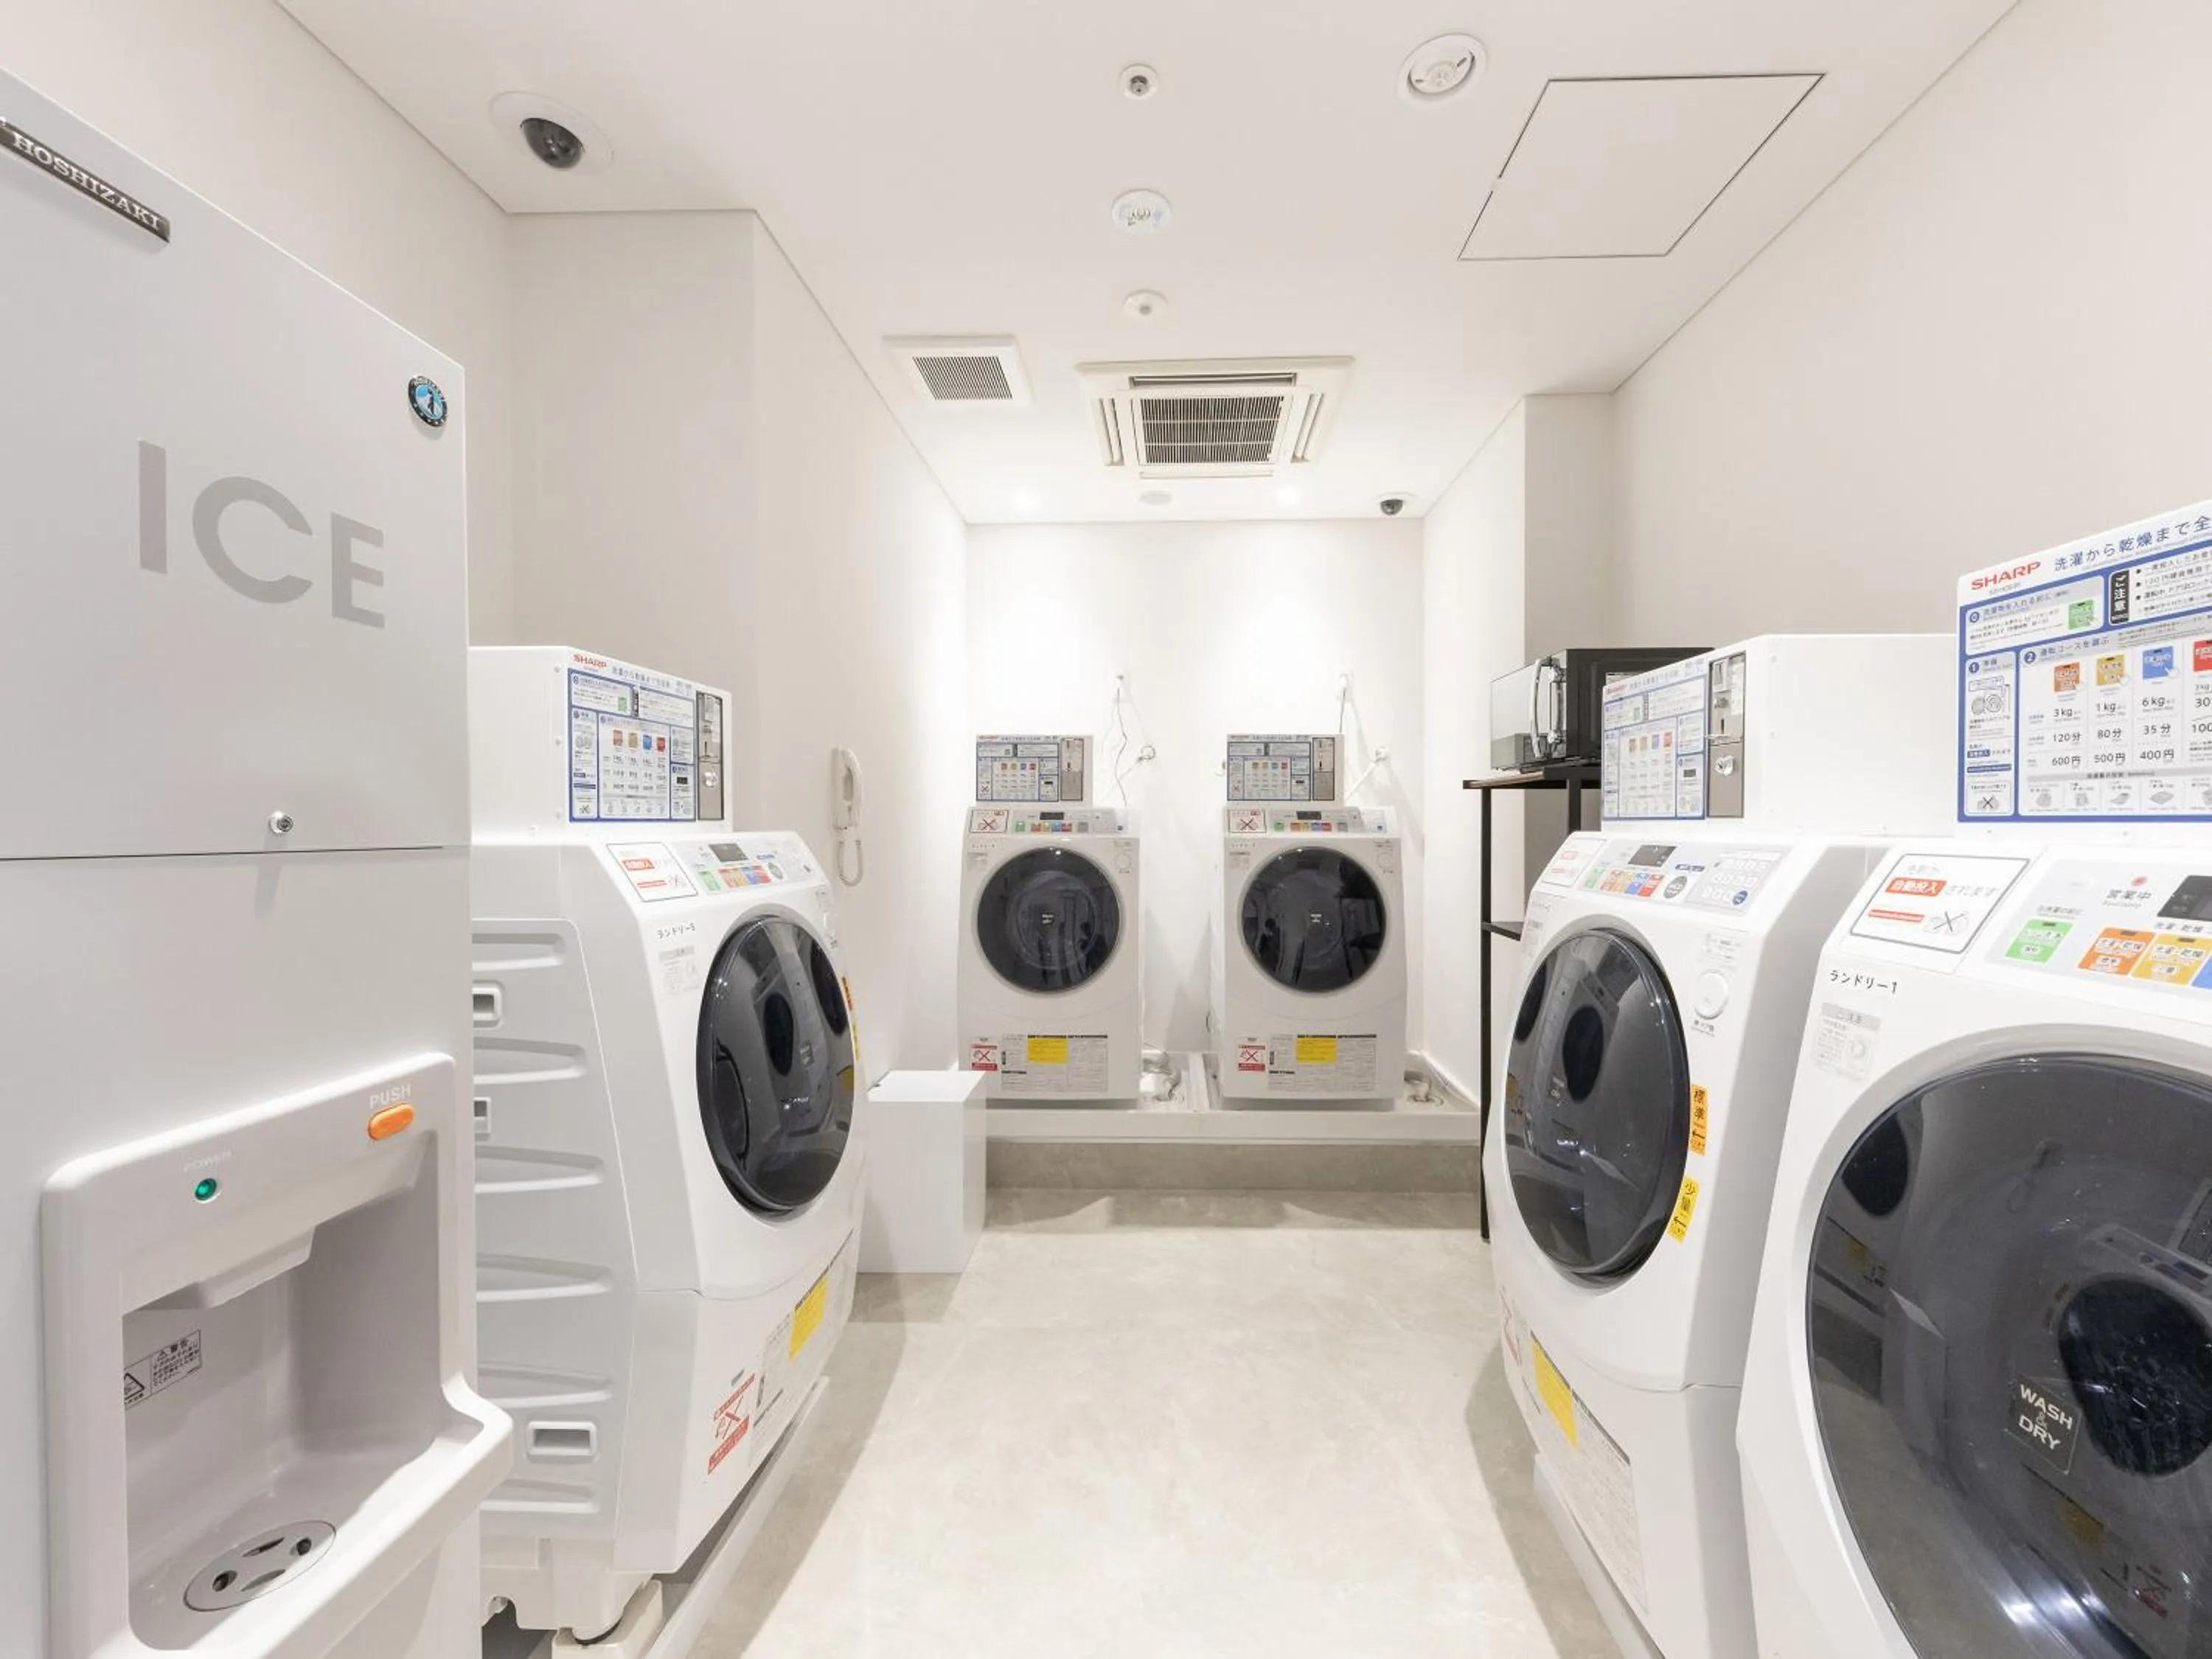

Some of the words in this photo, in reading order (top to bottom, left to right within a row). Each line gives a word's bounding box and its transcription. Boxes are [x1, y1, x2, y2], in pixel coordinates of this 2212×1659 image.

[13, 131, 161, 231] HOSHIZAKI
[138, 439, 386, 630] ICE
[1970, 561, 2041, 591] SHARP
[2052, 756, 2081, 766] 600円
[2094, 752, 2126, 764] 500円
[2140, 748, 2174, 760] 400円
[1829, 969, 1898, 995] ランドリー1
[369, 1084, 412, 1110] PUSH
[2019, 1383, 2073, 1430] WASH
[2018, 1415, 2061, 1451] DRY
